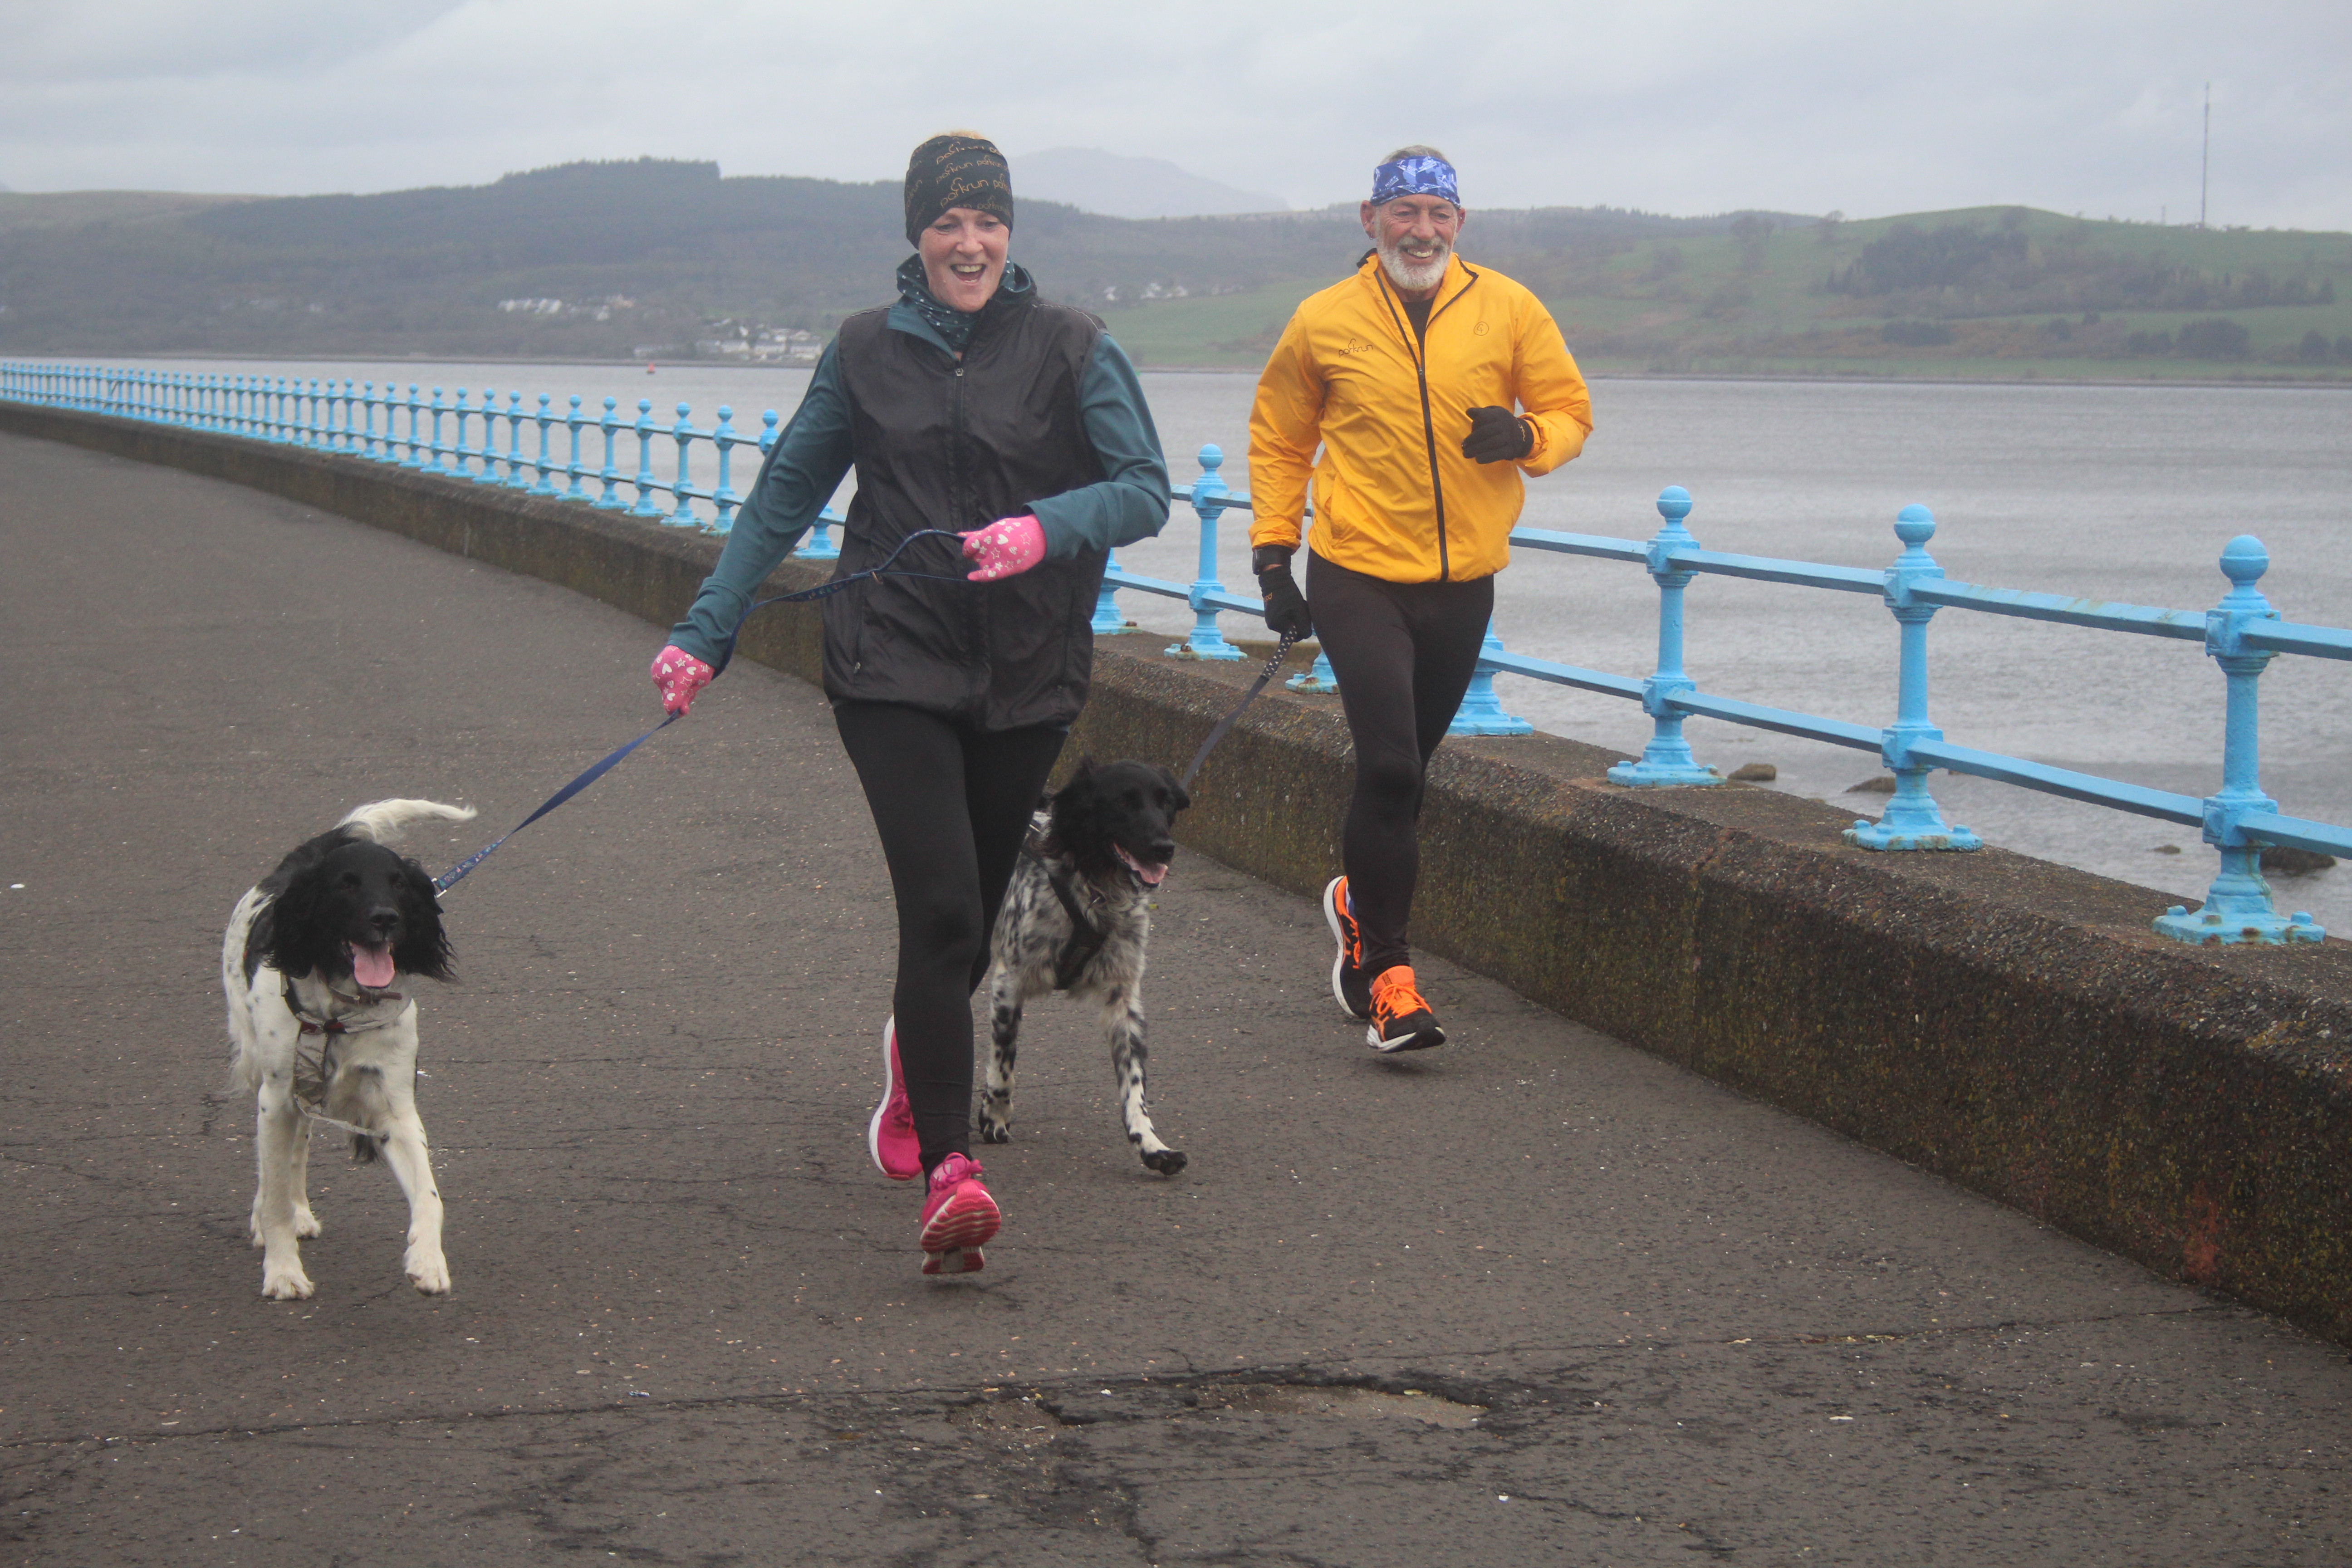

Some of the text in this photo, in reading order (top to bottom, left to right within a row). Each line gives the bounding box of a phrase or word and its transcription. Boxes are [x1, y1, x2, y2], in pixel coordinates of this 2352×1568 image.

[936, 163, 973, 184] parkrun
[940, 177, 989, 209] parkrun
[1338, 338, 1373, 358] parkrun
